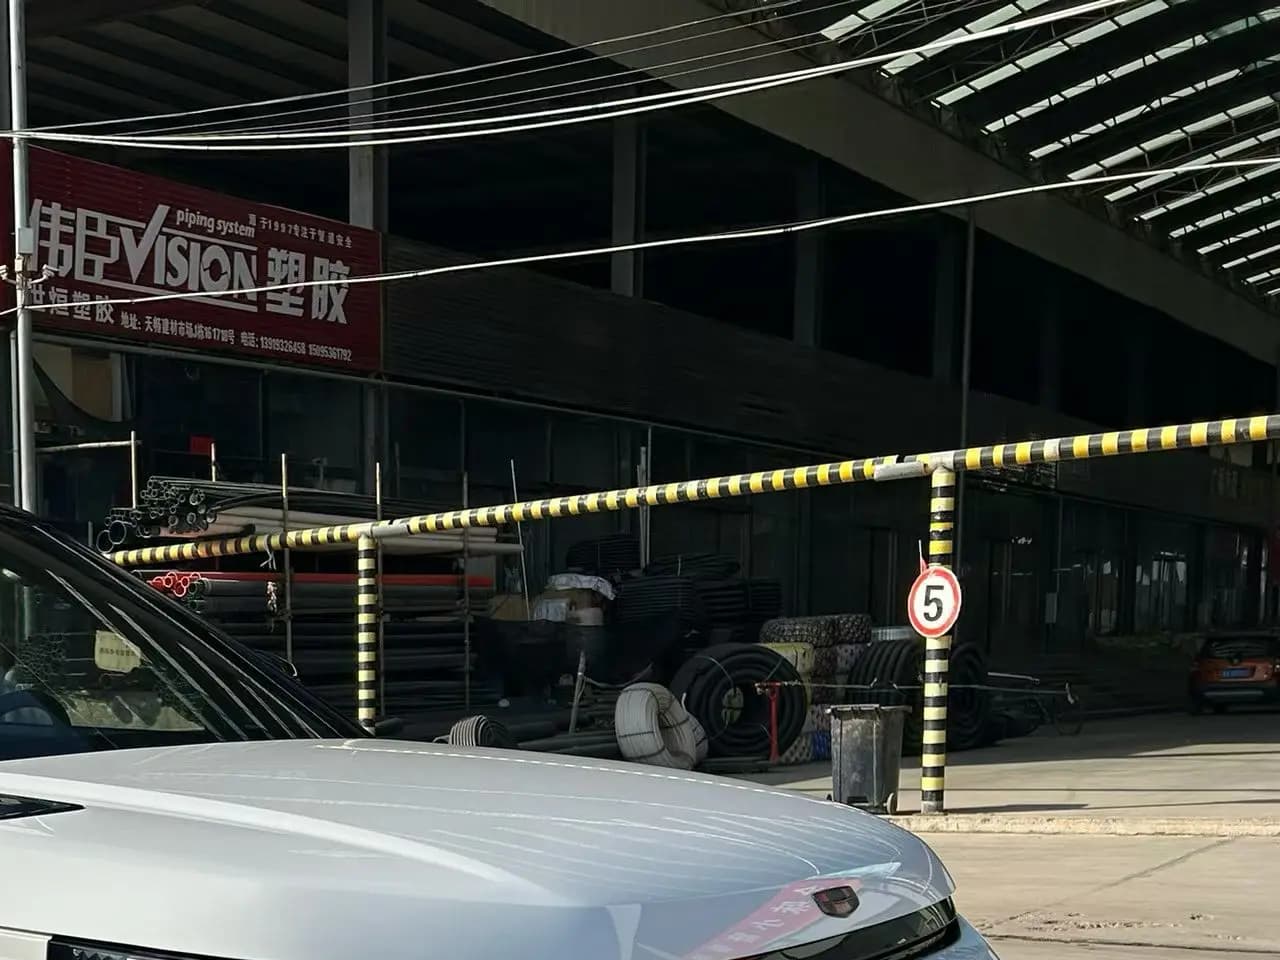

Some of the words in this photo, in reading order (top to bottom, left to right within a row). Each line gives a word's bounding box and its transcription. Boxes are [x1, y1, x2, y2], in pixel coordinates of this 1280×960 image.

[176, 208, 216, 233] piping
[216, 217, 256, 239] system
[120, 204, 258, 303] VISION
[266, 247, 352, 325] 塑胶
[923, 585, 944, 622] 5
